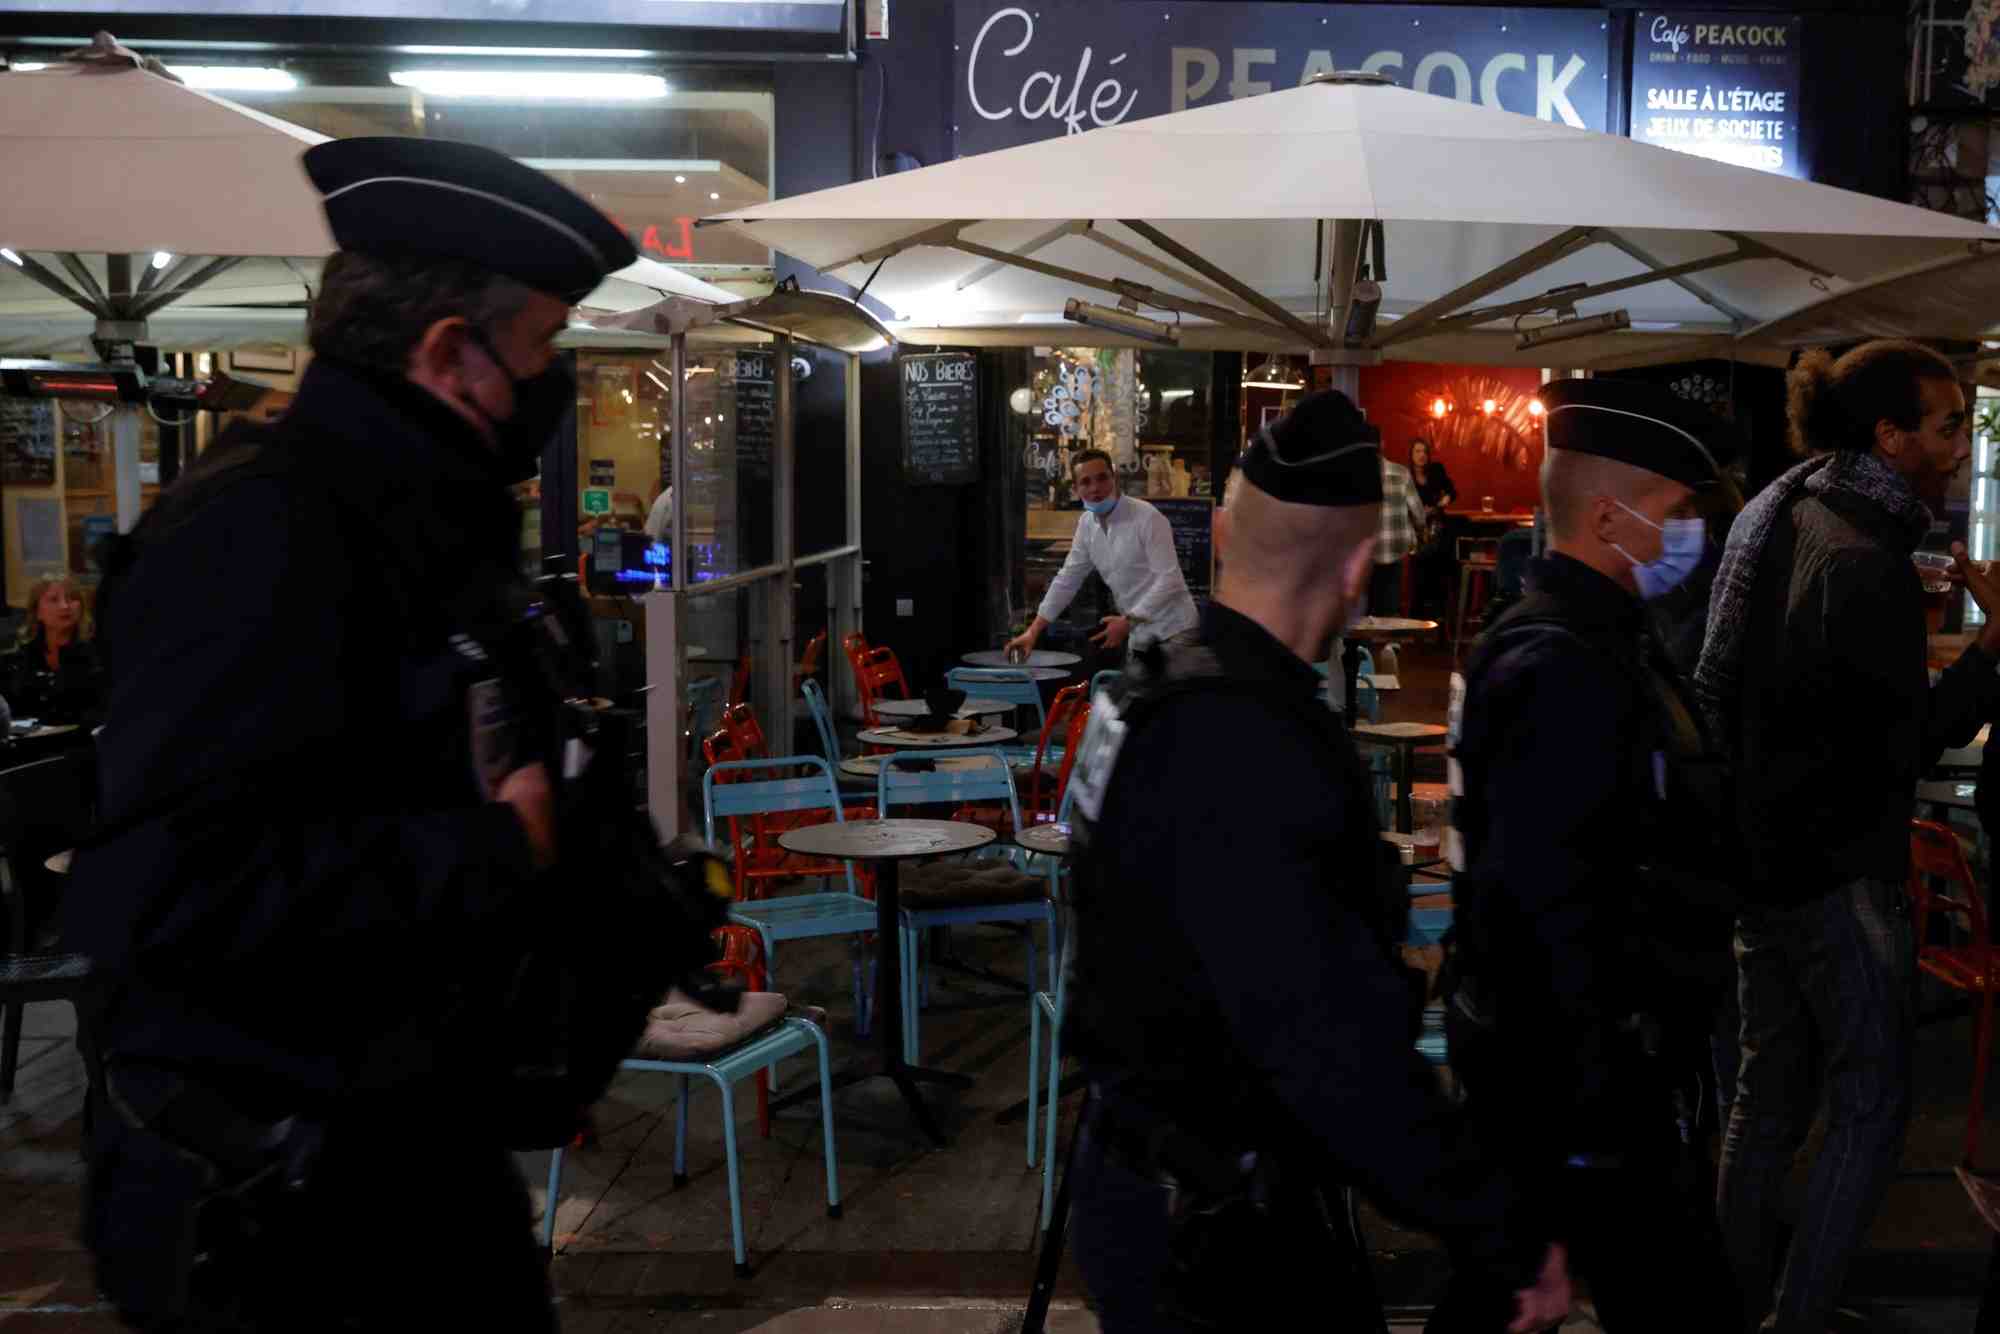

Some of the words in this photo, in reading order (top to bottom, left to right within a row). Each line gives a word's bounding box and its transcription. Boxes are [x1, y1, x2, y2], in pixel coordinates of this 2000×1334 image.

[1650, 16, 1690, 52] Café
[1695, 25, 1787, 46] PEACOCK
[968, 7, 1138, 134] Café
[1647, 88, 1699, 110] SALLE
[1700, 84, 1715, 110] À
[1718, 85, 1785, 112] L'ÉTAGE
[1646, 116, 1689, 138] JEUX
[1692, 117, 1714, 138] DE
[1717, 118, 1784, 140] SOCIETE
[905, 361, 929, 382] NOS
